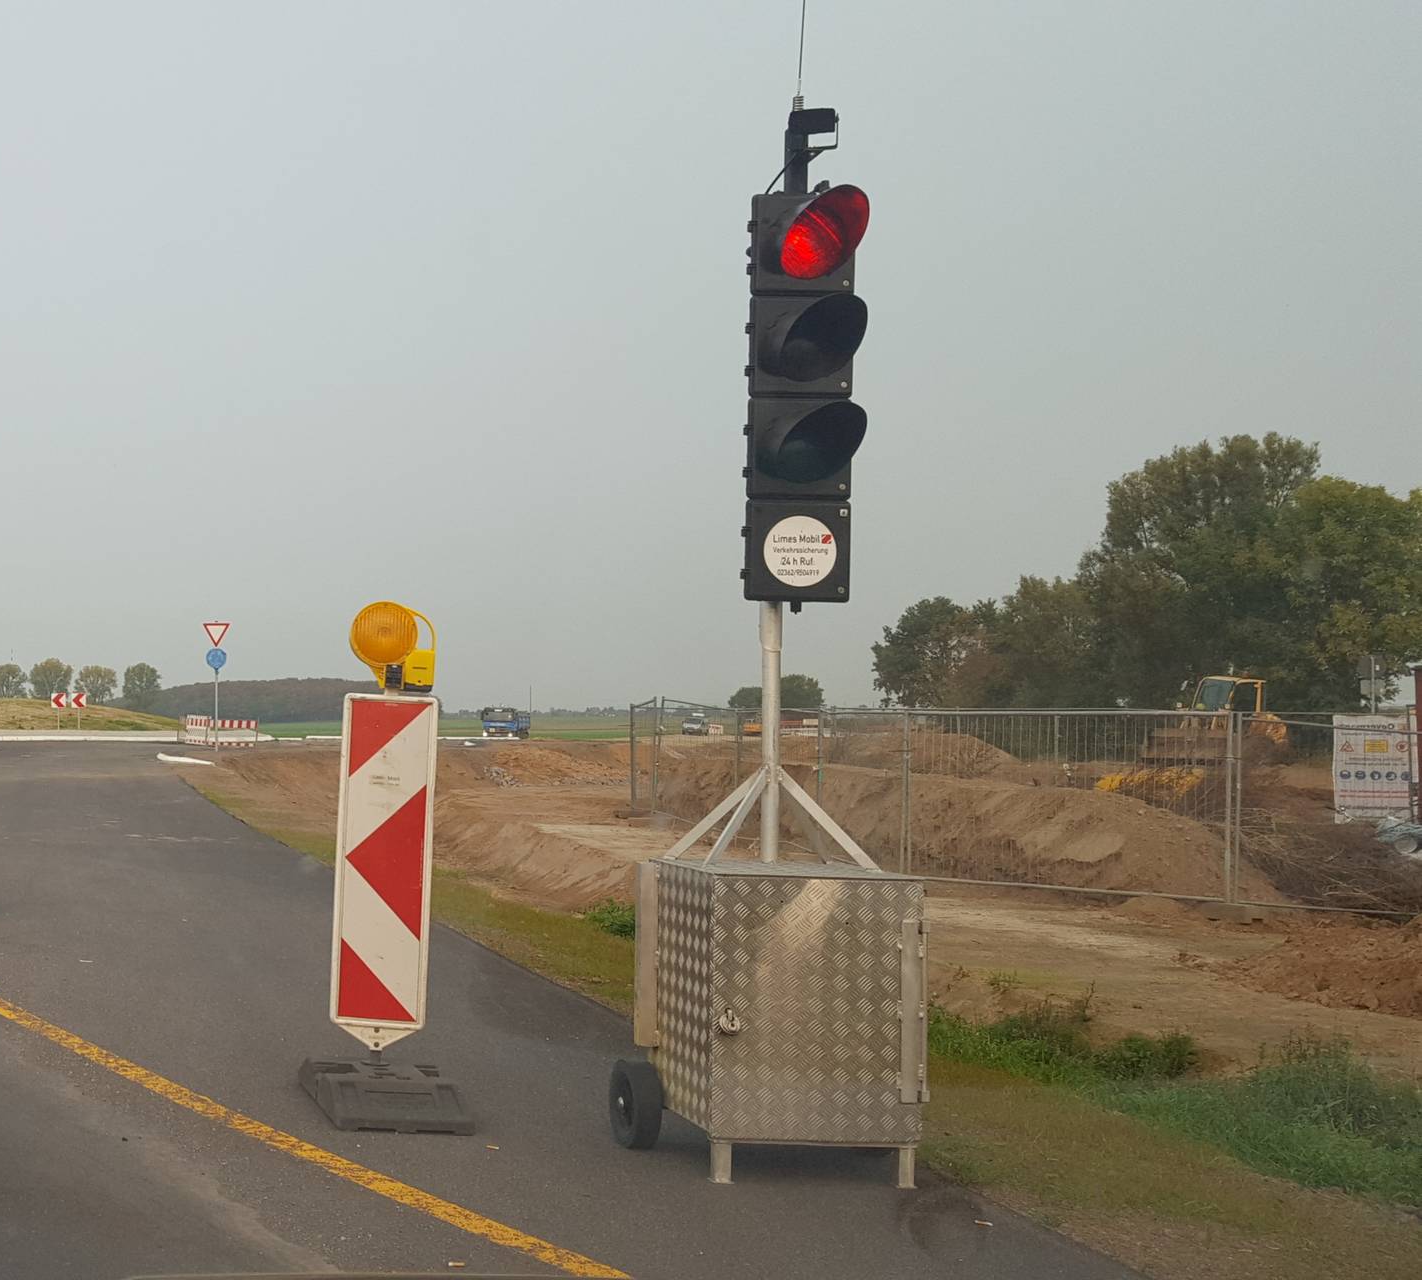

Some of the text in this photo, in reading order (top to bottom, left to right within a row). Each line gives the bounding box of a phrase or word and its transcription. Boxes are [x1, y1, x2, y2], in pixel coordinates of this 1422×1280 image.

[773, 535, 820, 543] Limes Mobil
[773, 547, 828, 555] Verkehrssicherung
[781, 557, 791, 565] 24
[792, 557, 798, 565] h
